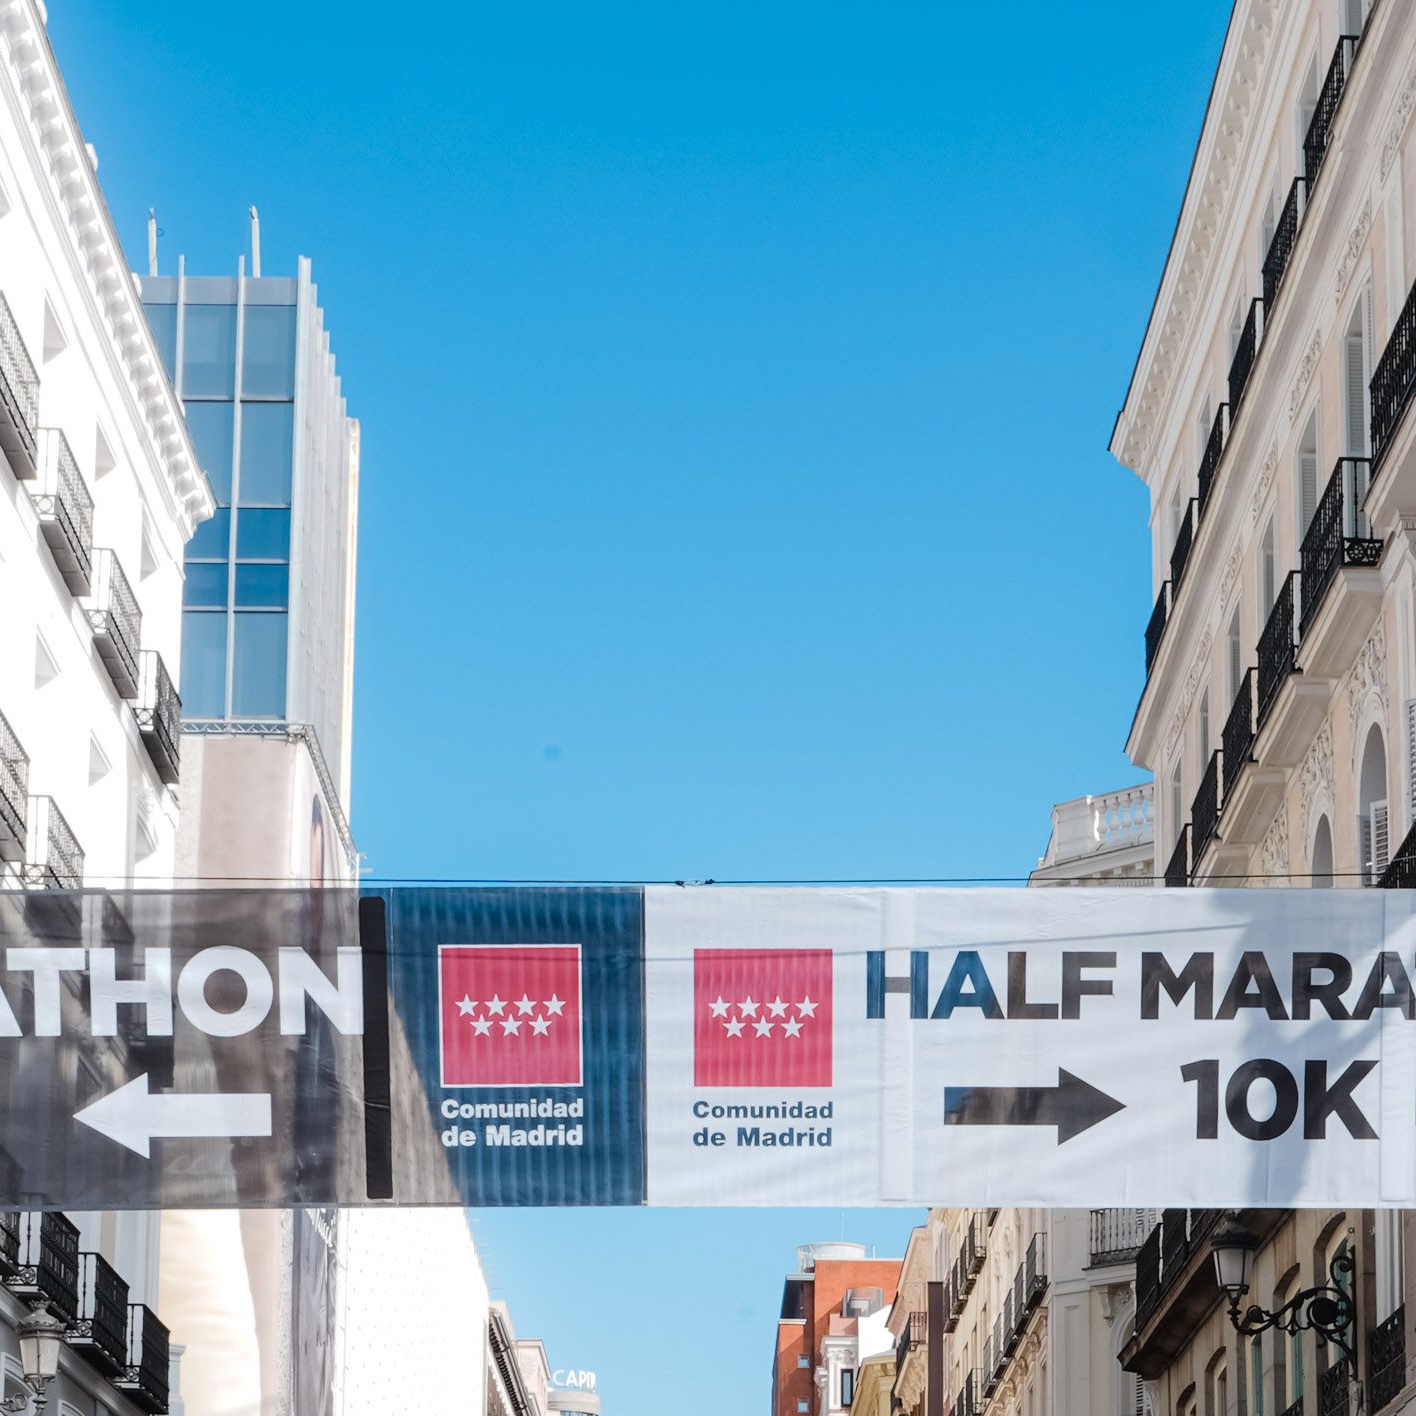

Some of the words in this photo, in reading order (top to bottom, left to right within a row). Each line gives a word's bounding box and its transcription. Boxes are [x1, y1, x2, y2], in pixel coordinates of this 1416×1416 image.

[865, 950, 1117, 1022] HALF
[440, 1099, 584, 1119] Comunidad
[692, 1100, 834, 1121] Comunidad
[1180, 1058, 1379, 1142] 10K
[441, 1125, 475, 1146] de
[486, 1124, 584, 1147] Madrid
[693, 1127, 726, 1147] de
[736, 1127, 834, 1149] Madrid
